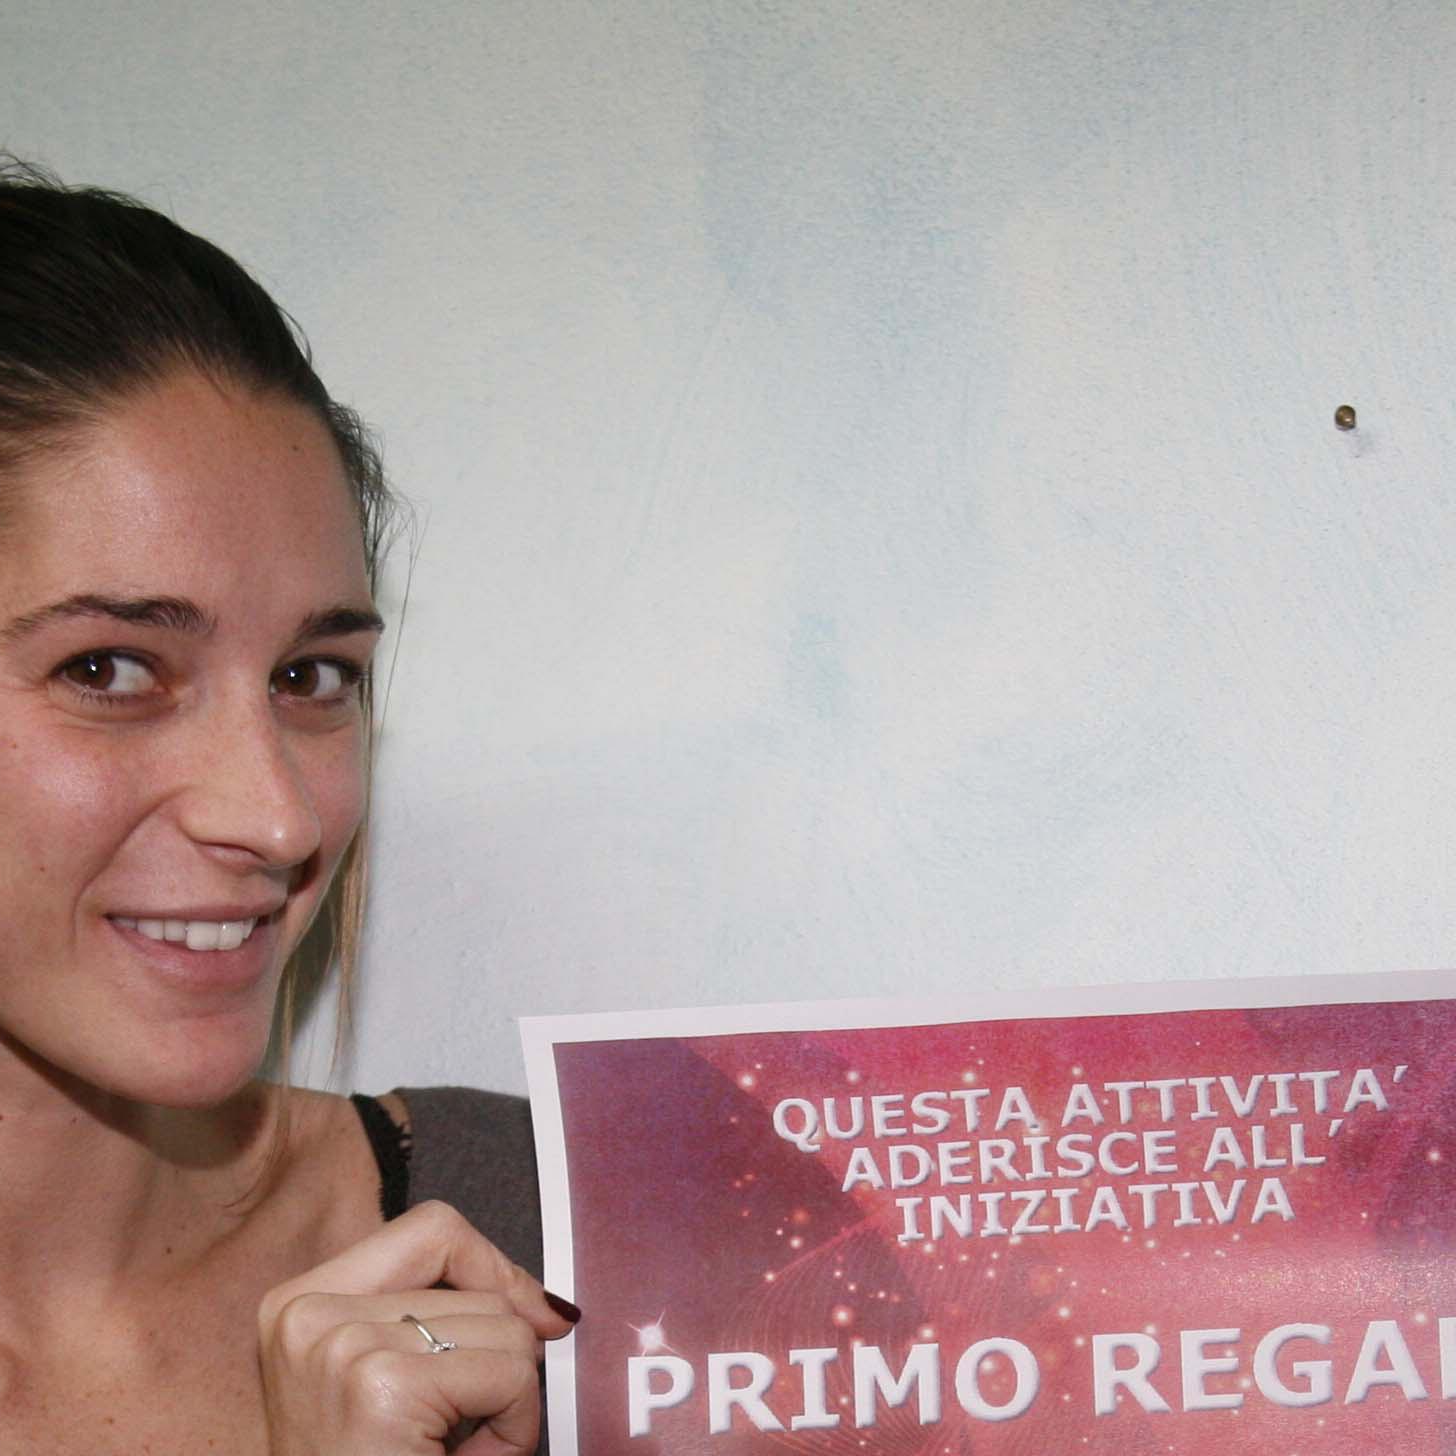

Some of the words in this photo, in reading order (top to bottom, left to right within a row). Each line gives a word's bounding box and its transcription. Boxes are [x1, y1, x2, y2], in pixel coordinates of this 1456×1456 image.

[773, 1087, 1034, 1150] QUESTA
[842, 1130, 1179, 1191] ADERISCE
[896, 1178, 1294, 1242] INIZIATIVA
[627, 1337, 1040, 1438] PRIMO
